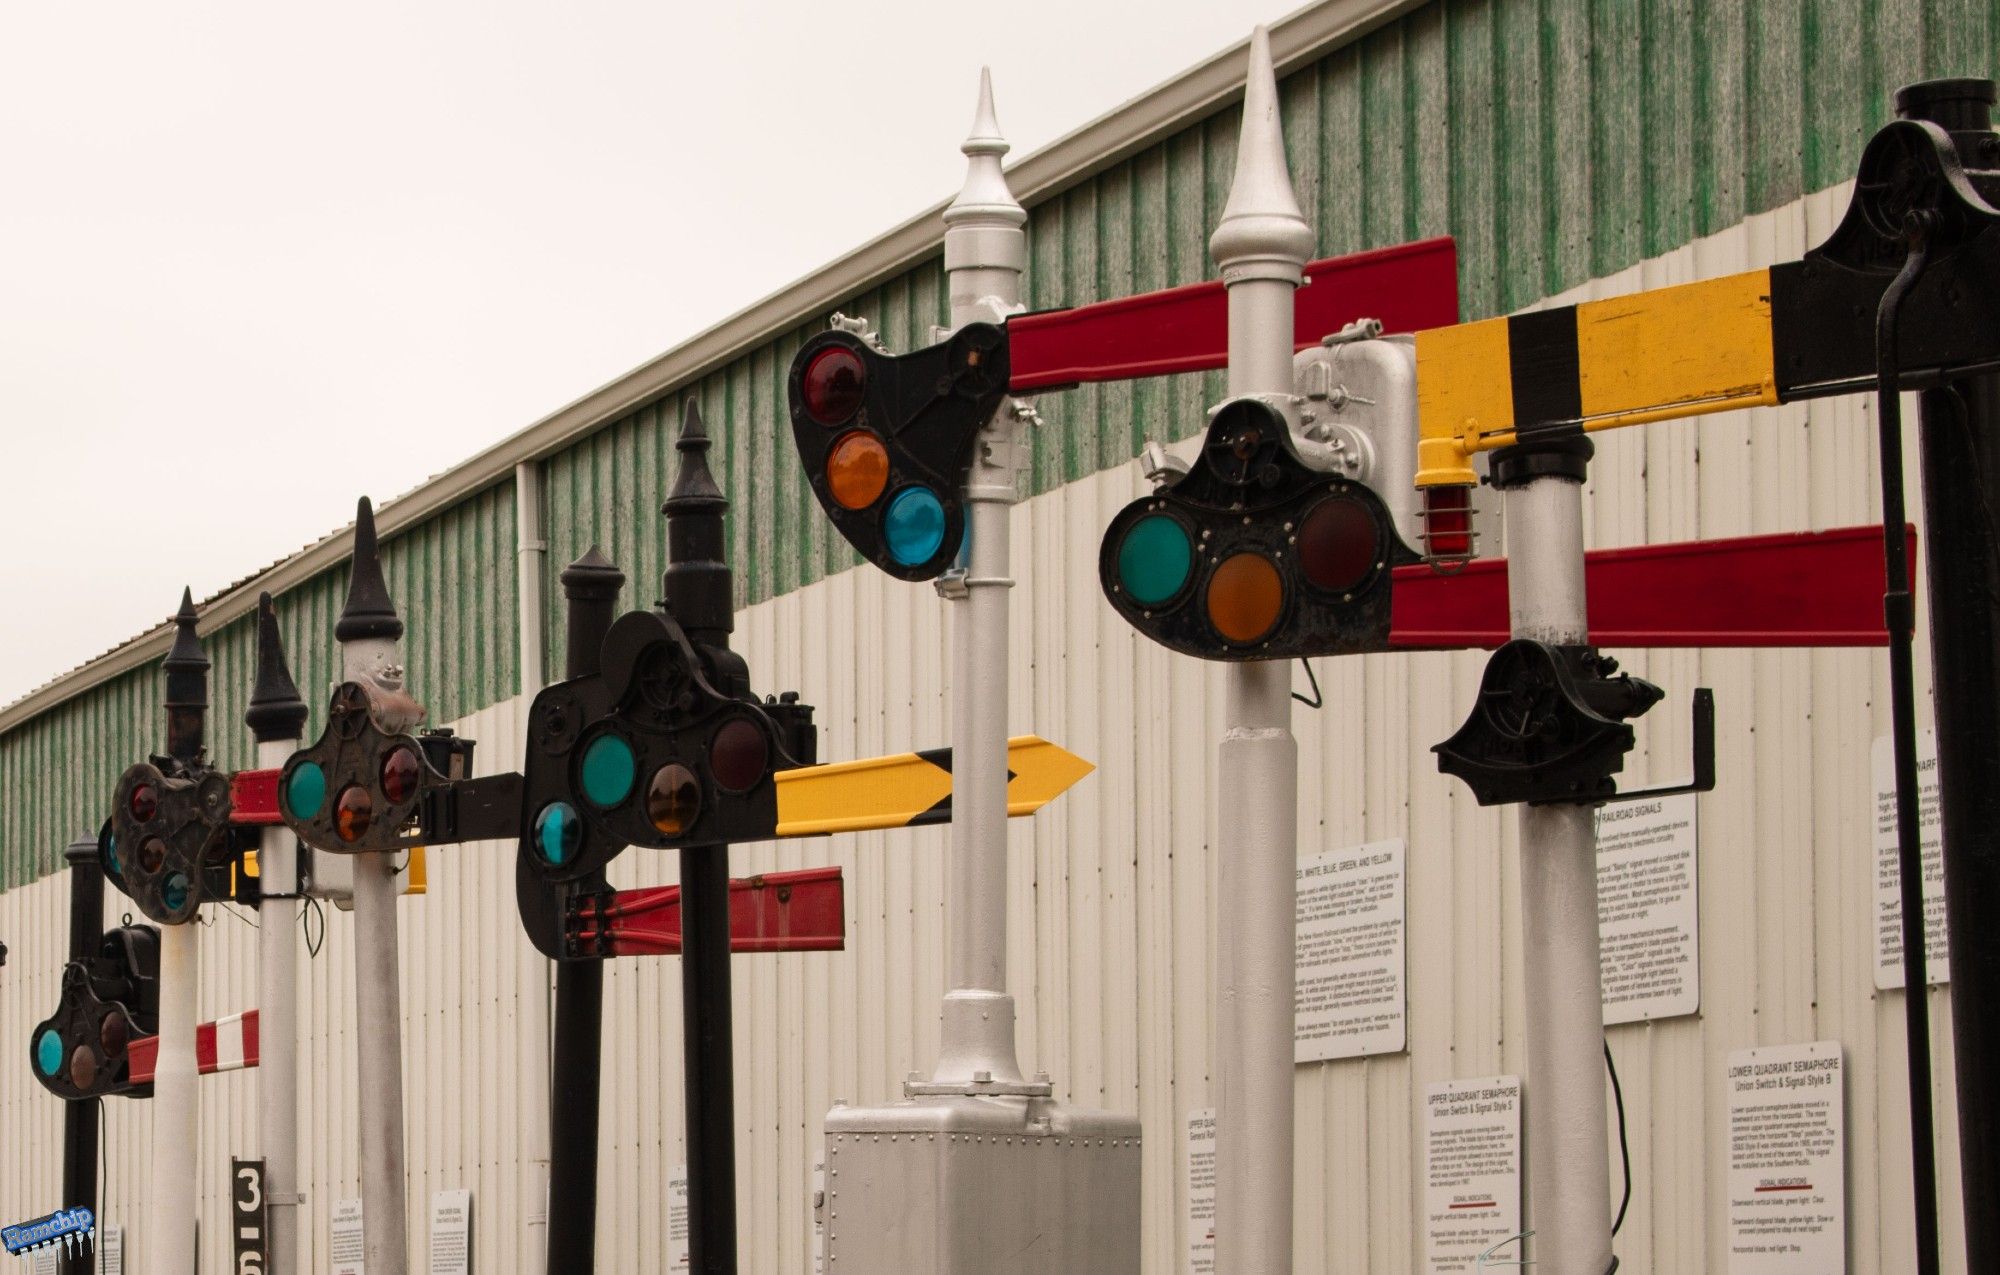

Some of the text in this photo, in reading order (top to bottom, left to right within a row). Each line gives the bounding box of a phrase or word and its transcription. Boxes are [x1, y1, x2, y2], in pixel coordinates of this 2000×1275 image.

[1602, 802, 1661, 823] RAILROAD SIGNALS
[1728, 1058, 1838, 1078] LOWER QUADRANT SEMAPHORE
[1735, 1074, 1830, 1091] Union Switch & Signal Style B
[1428, 1087, 1517, 1105] UPPER QUADRANT SEMAPHORE
[1433, 1100, 1511, 1117] Union Switch & Signal Style S
